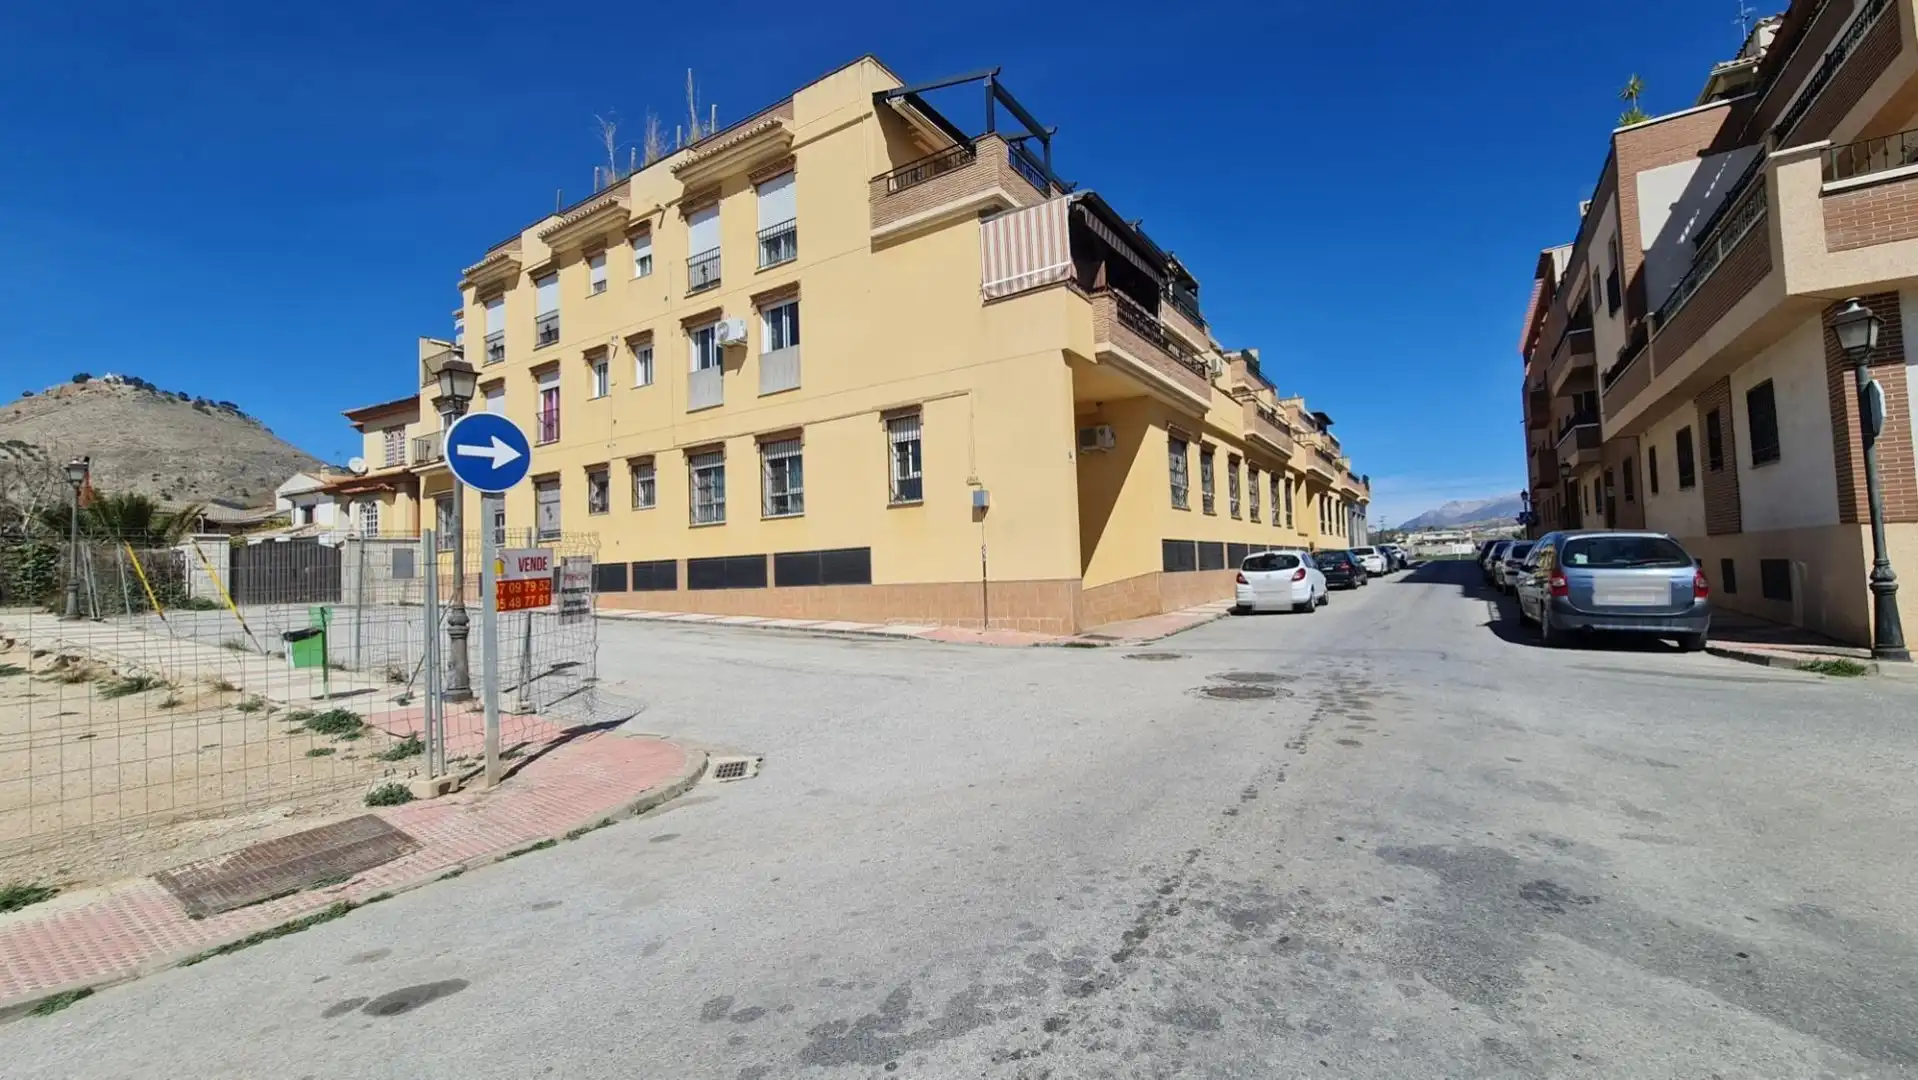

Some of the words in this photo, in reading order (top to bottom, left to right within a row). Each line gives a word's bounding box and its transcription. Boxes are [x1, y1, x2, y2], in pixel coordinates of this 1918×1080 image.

[518, 556, 548, 572] VENDE
[509, 582, 522, 594] 09
[524, 581, 536, 592] 79
[538, 580, 550, 591] 52
[508, 597, 522, 609] 48
[524, 596, 536, 607] 77
[538, 594, 549, 606] 81
